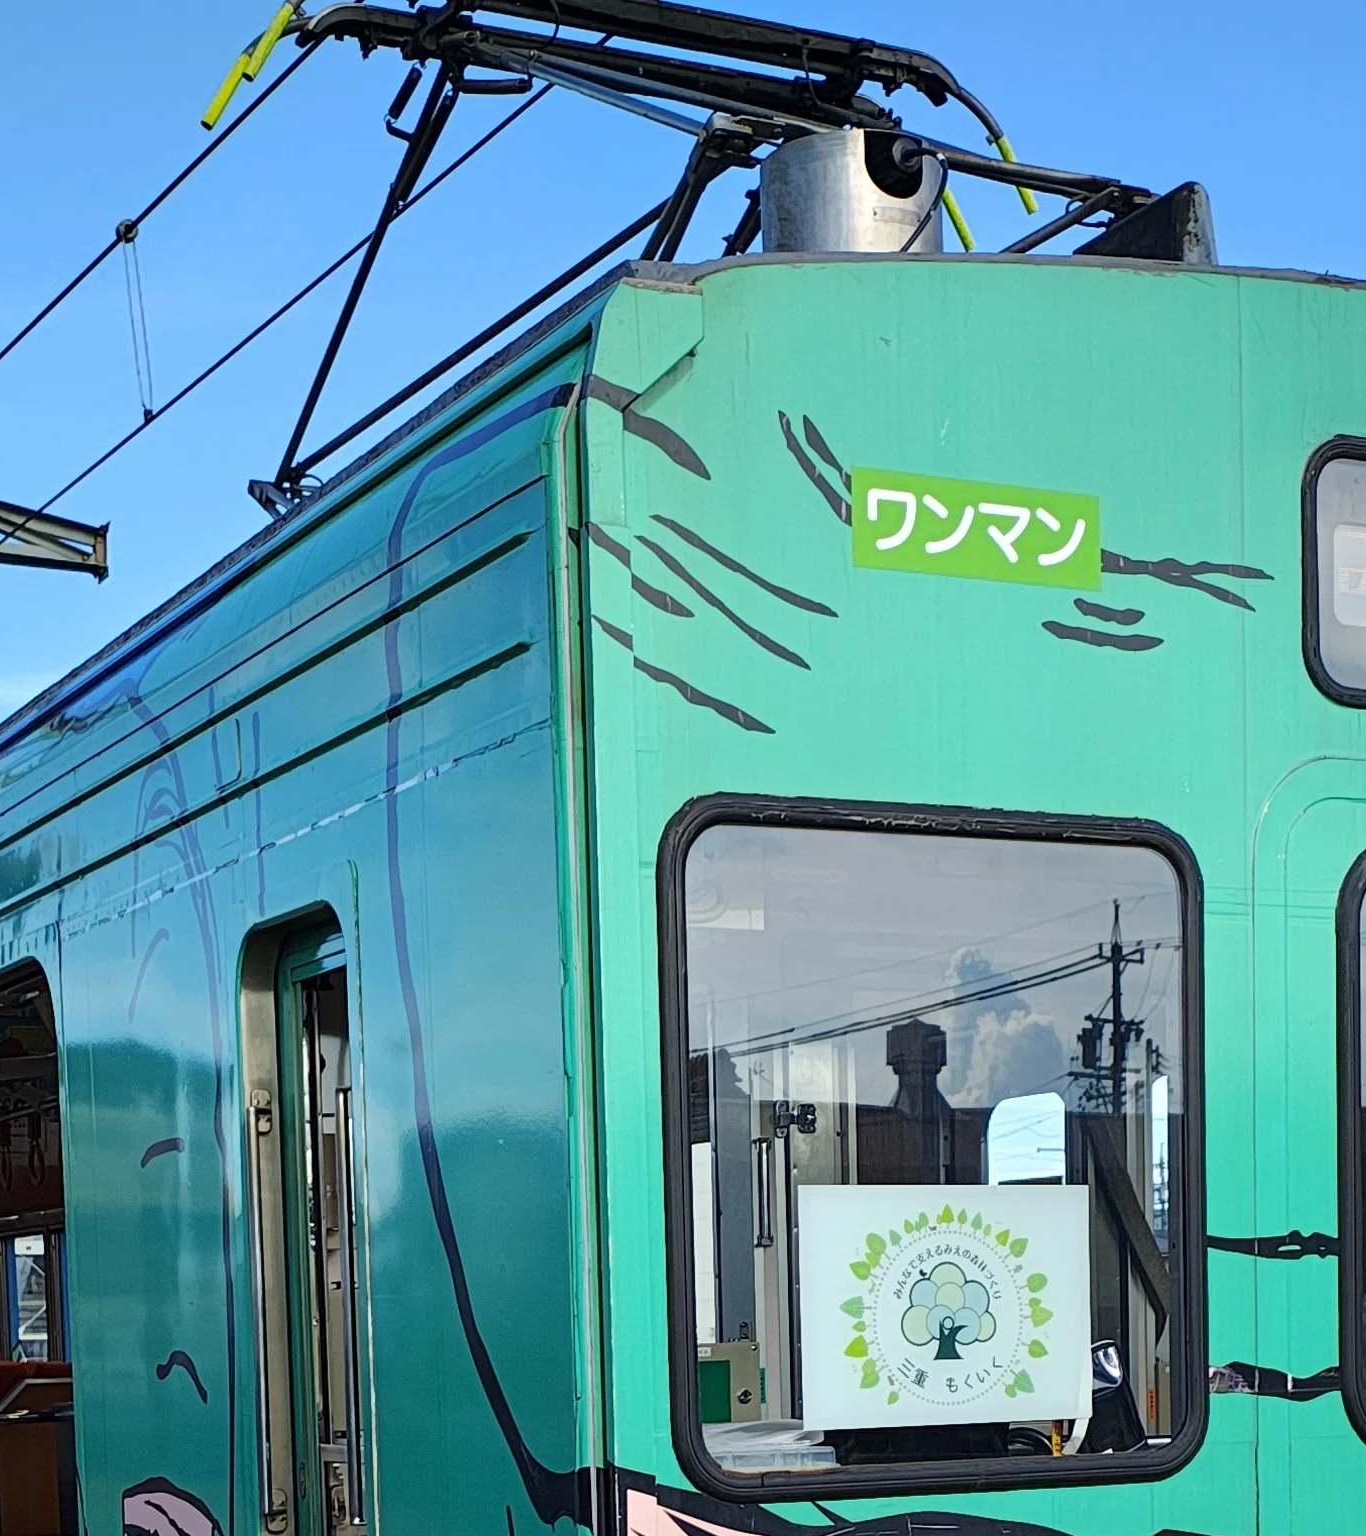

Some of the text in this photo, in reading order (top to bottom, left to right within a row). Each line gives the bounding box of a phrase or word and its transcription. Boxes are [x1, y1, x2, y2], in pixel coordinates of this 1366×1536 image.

[866, 487, 1086, 566] ワンマン
[896, 1355, 1004, 1394] 三重 もくいく
